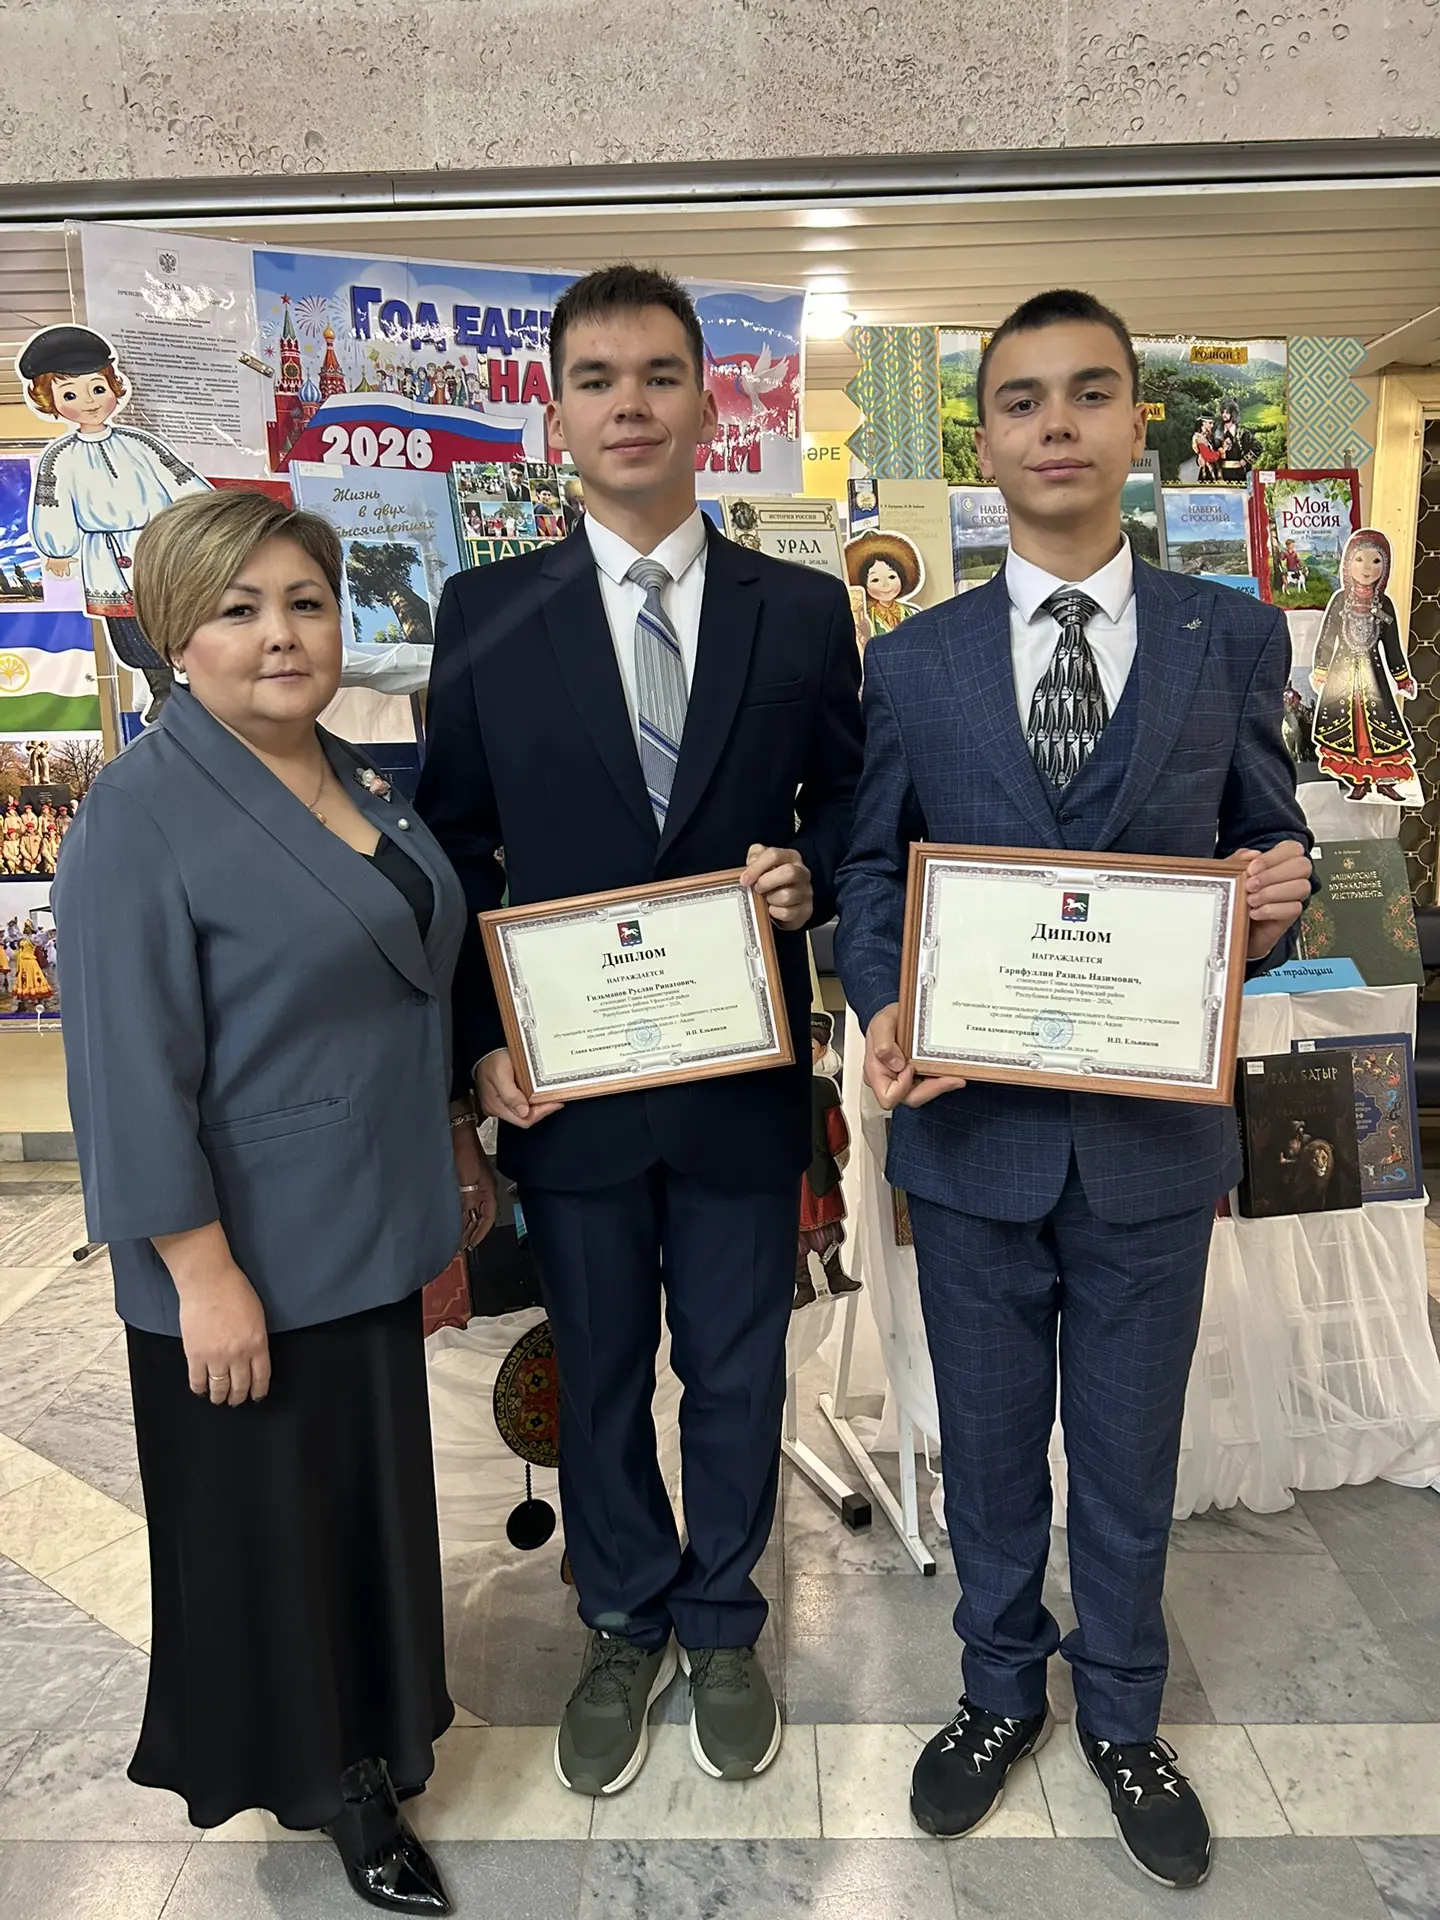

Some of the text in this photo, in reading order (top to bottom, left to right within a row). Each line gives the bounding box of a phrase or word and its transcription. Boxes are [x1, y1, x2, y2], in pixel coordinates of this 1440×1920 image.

[322, 425, 434, 470] 2026
[803, 446, 841, 461] ӘРЕ
[332, 488, 380, 502] Жизнь
[358, 504, 405, 520] в двух
[1188, 505, 1222, 514] НАВЕКИ
[972, 516, 978, 524] С
[1181, 512, 1230, 522] С РОССИЕЙ
[776, 538, 822, 554] УРАЛ
[1331, 890, 1384, 900] ИНСТРУМЕНТЫ
[1030, 922, 1112, 944] Диплом
[602, 947, 666, 969] Диплом
[1031, 952, 1103, 964] НАГРАЖДАЕТСЯ
[606, 969, 665, 984] НАГРАЖДАЕТСЯ
[999, 966, 1142, 984] Гарифуллин Разиль Назимович,
[1282, 966, 1334, 978] традиции
[586, 978, 697, 1002] Гильманов Руслан Ринатович,
[1107, 991, 1126, 999] район
[966, 1024, 1040, 1037] Глава администрации
